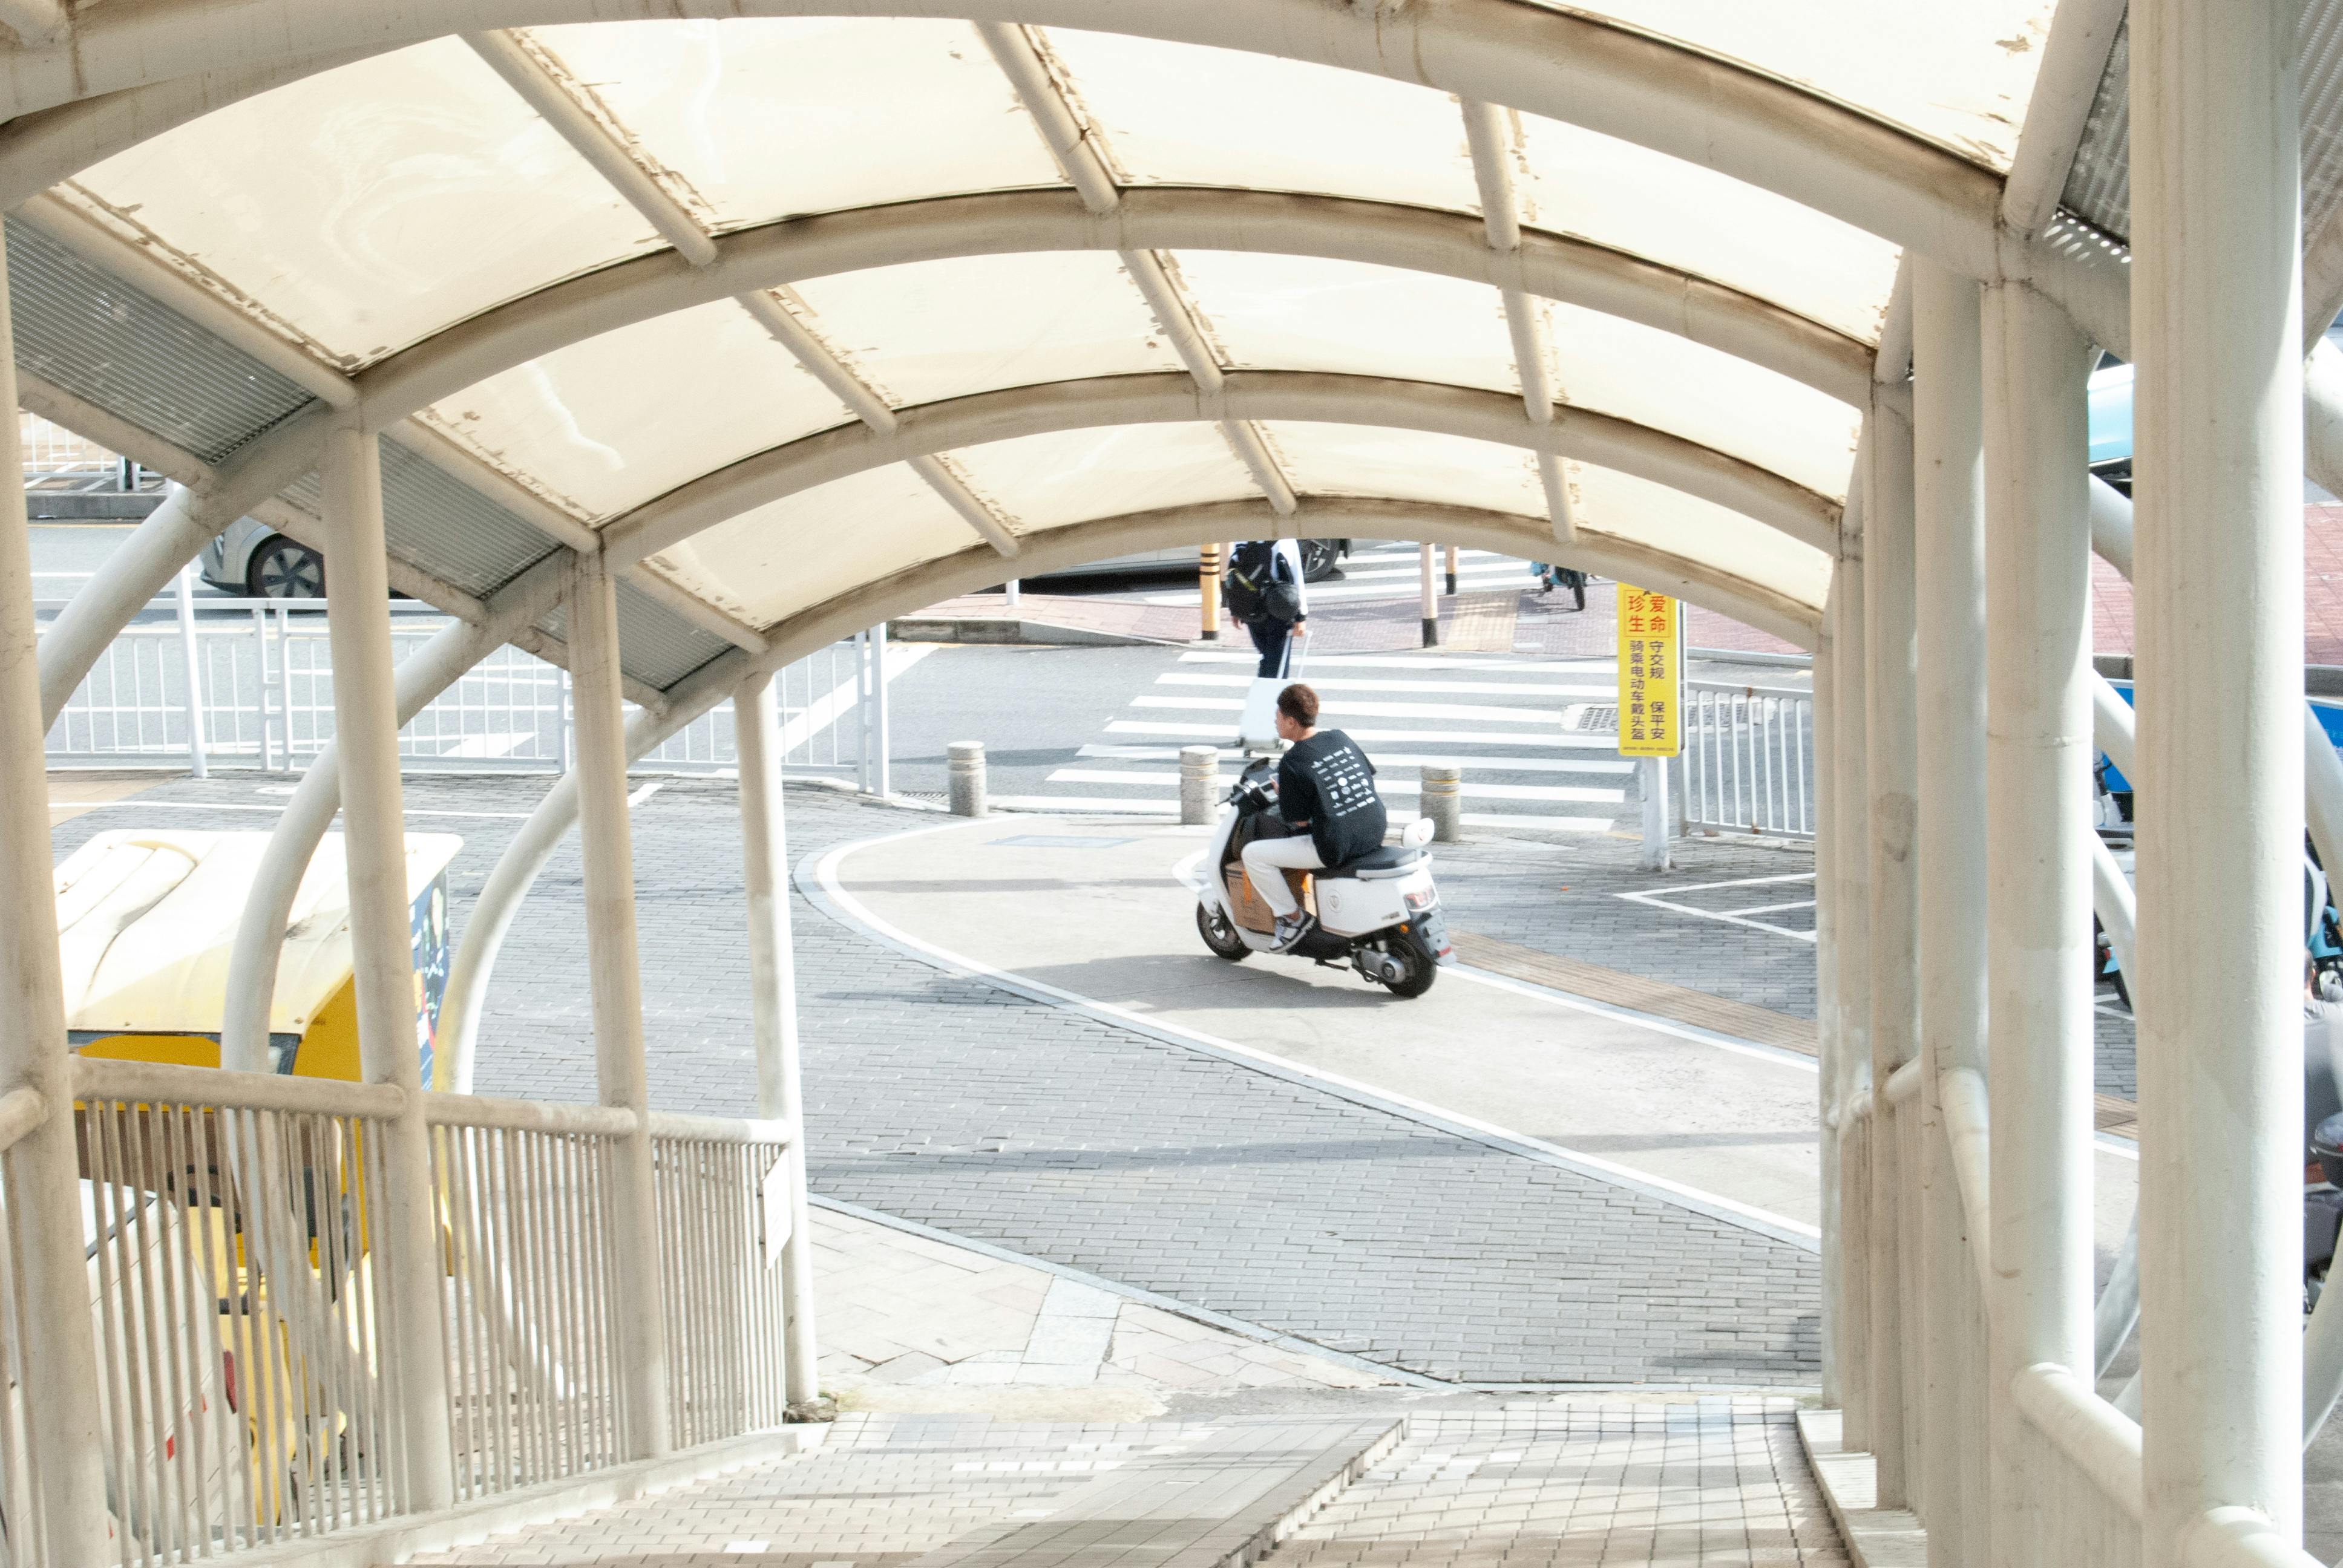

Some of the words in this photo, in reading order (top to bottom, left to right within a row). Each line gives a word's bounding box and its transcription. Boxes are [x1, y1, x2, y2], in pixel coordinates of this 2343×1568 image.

[1628, 595, 1666, 612] 珍爱
[1628, 615, 1666, 633] 生命
[1650, 640, 1665, 679] 守交规
[1630, 640, 1645, 740] 骑乘电动车戴头盔
[1650, 701, 1665, 739] 保平安
